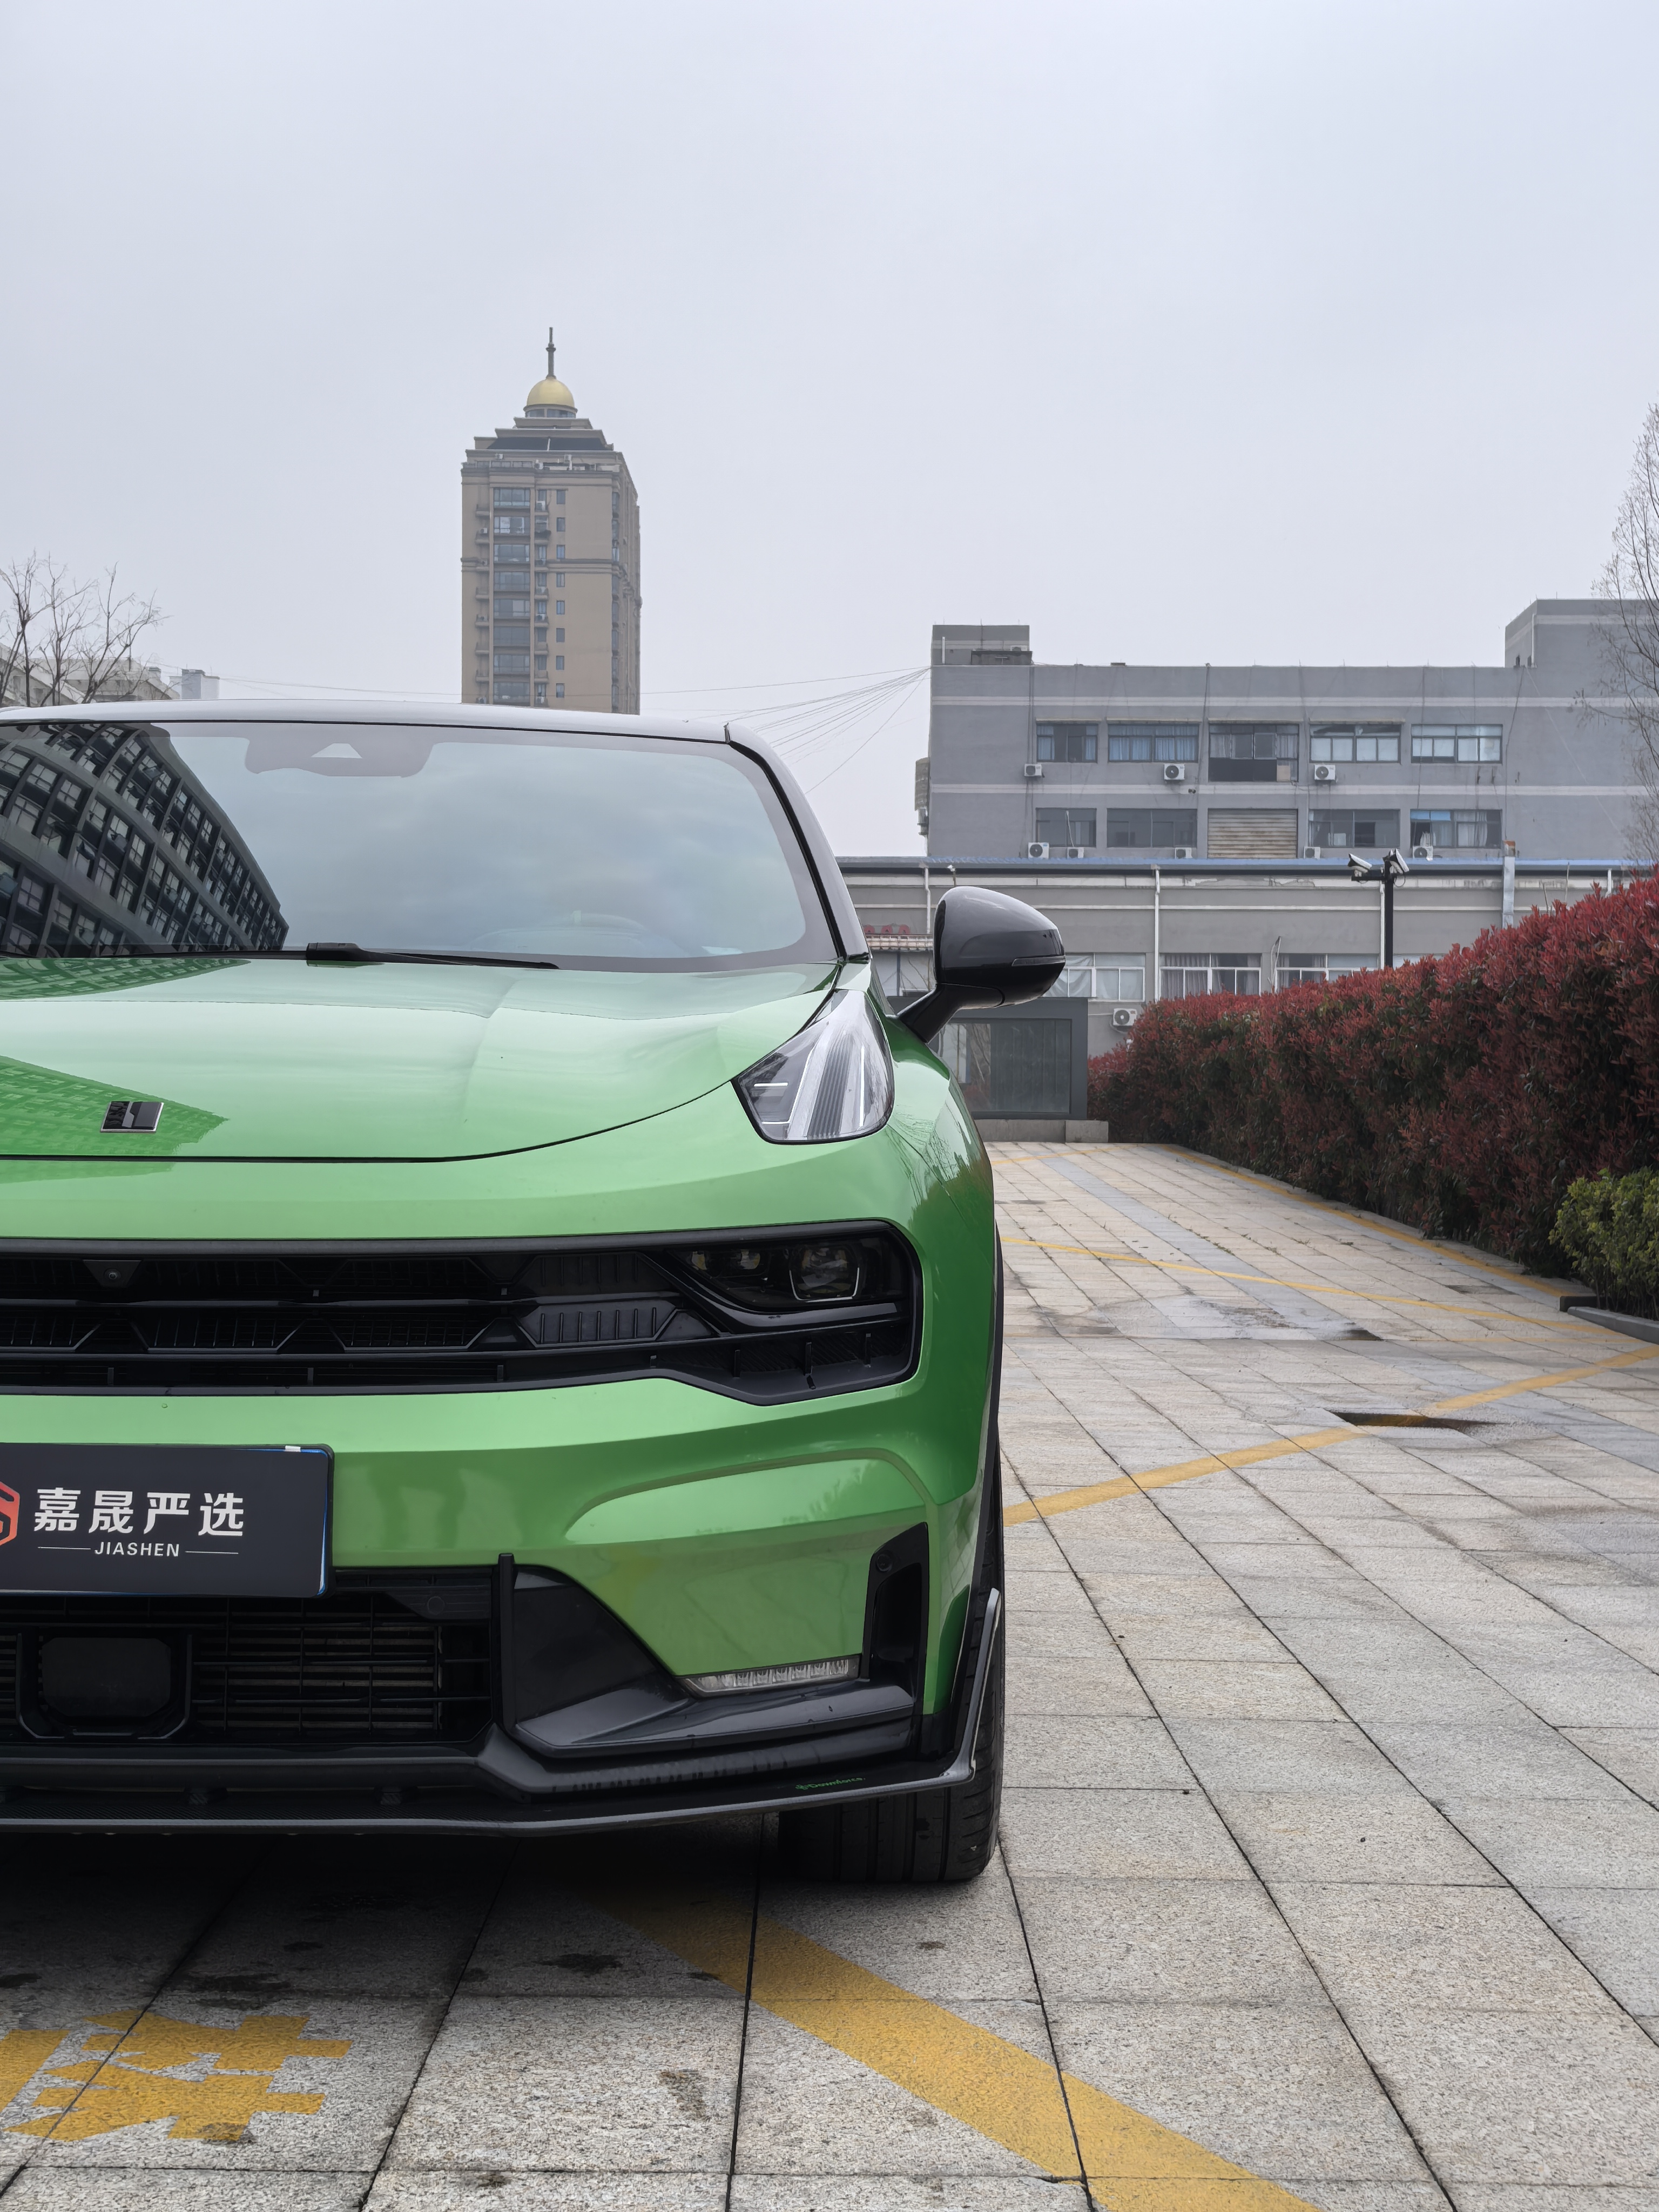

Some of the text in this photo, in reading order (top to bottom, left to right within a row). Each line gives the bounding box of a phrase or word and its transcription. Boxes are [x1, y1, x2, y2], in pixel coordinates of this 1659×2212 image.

[33, 1487, 244, 1536] 嘉晟严选
[94, 1541, 180, 1557] JIASHEN
